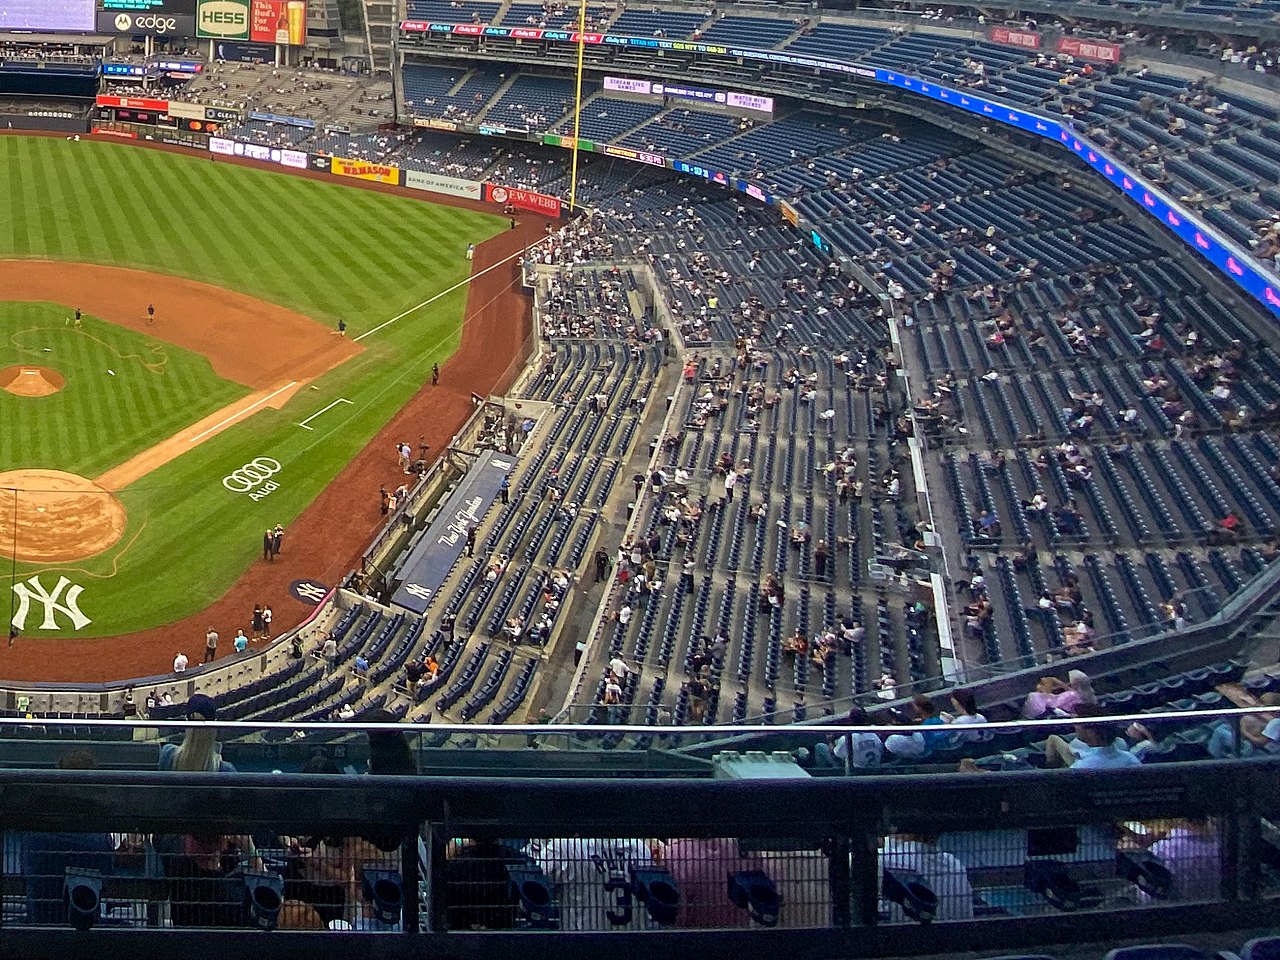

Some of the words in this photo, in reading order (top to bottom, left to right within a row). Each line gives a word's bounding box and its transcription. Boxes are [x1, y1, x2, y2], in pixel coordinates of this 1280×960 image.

[254, 1, 272, 9] This
[202, 11, 245, 25] HESS
[254, 9, 275, 17] Bud's
[135, 14, 176, 34] edge
[254, 24, 271, 32] You.
[435, 182, 464, 191] AMERICA
[530, 196, 557, 210] WEBB
[247, 480, 281, 502] Audi
[456, 496, 483, 523] Yankees
[447, 515, 469, 537] York
[437, 530, 459, 547] New
[11, 575, 93, 631] NY
